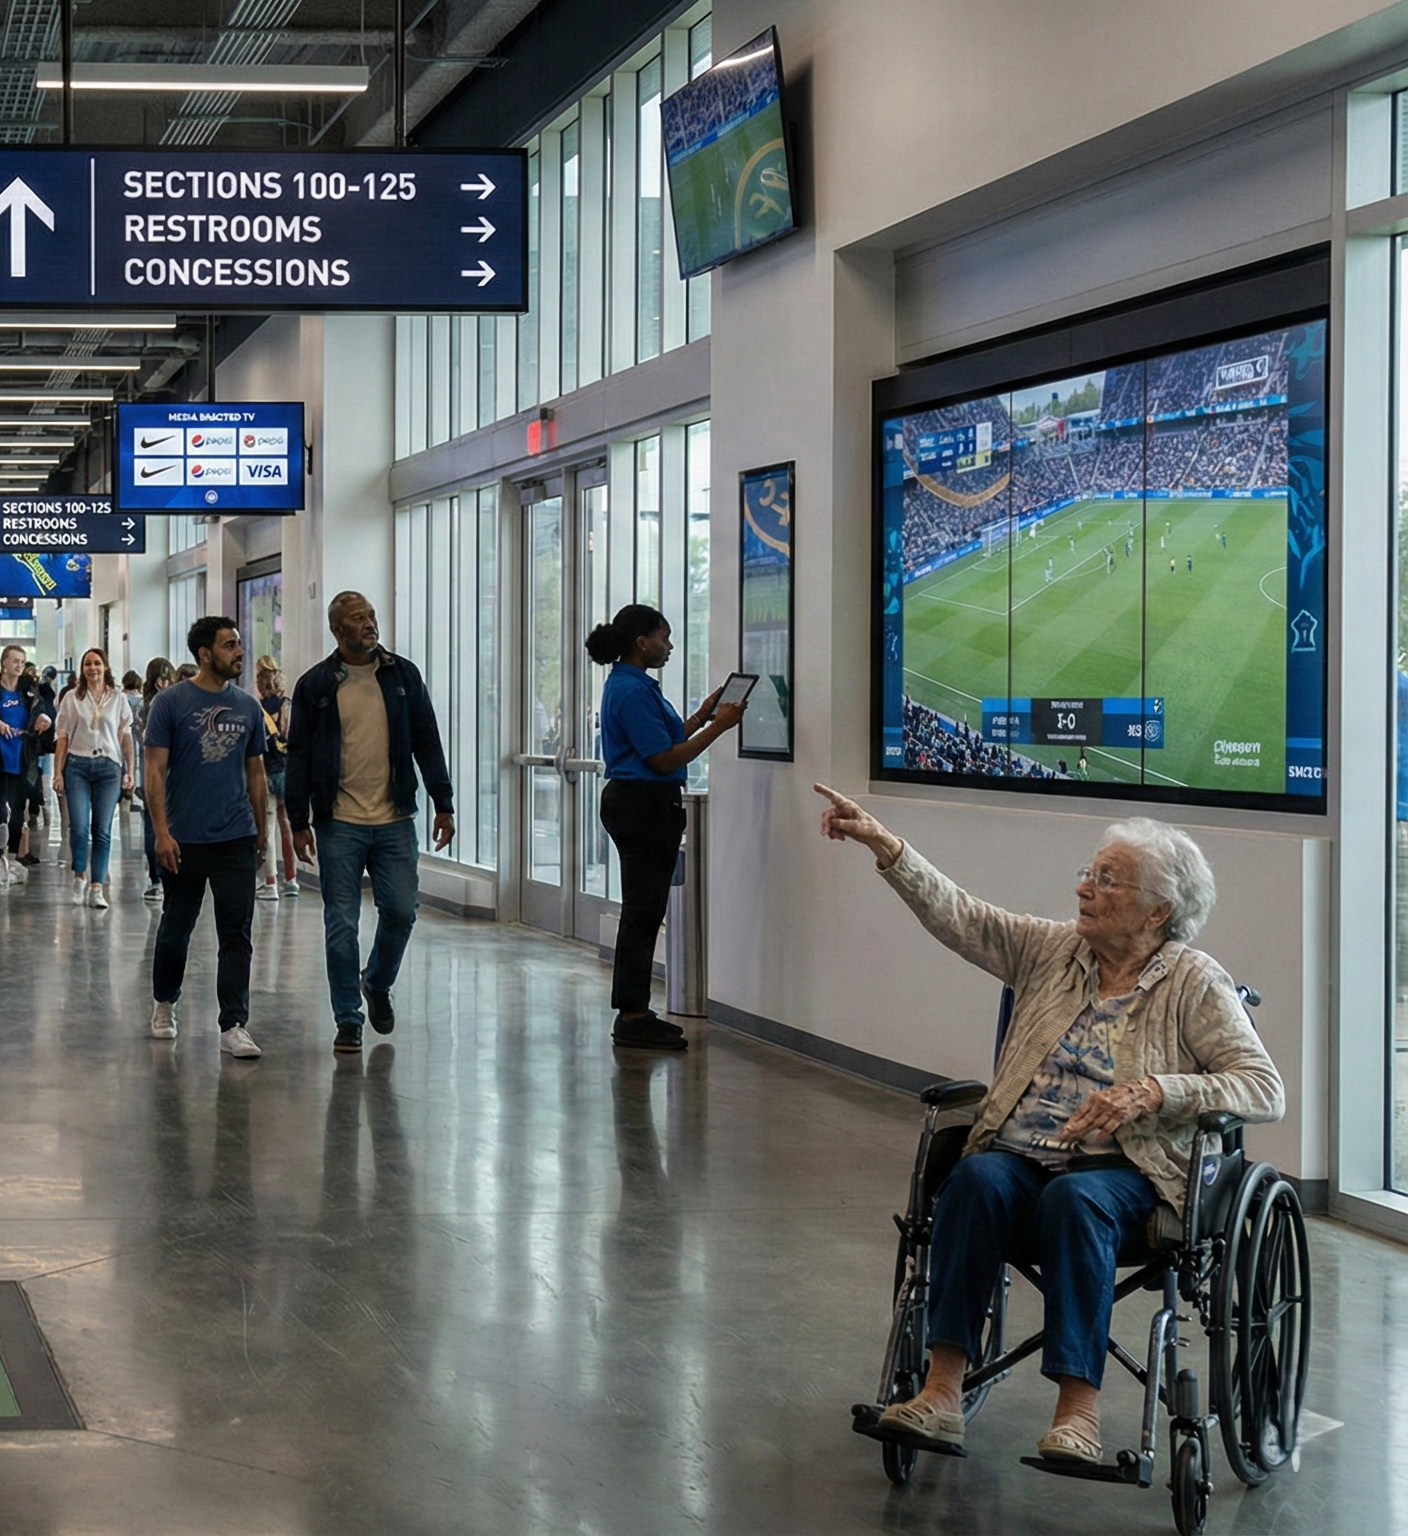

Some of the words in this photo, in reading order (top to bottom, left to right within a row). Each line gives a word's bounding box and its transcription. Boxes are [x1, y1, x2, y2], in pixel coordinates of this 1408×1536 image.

[123, 171, 282, 199] SECTIONS
[293, 172, 417, 200] 100-125
[125, 214, 322, 243] RESTROOMS
[125, 258, 350, 286] CONCESSIONS
[242, 412, 255, 422] TV
[246, 465, 282, 478] VISA
[2, 502, 63, 514] SECTIONS
